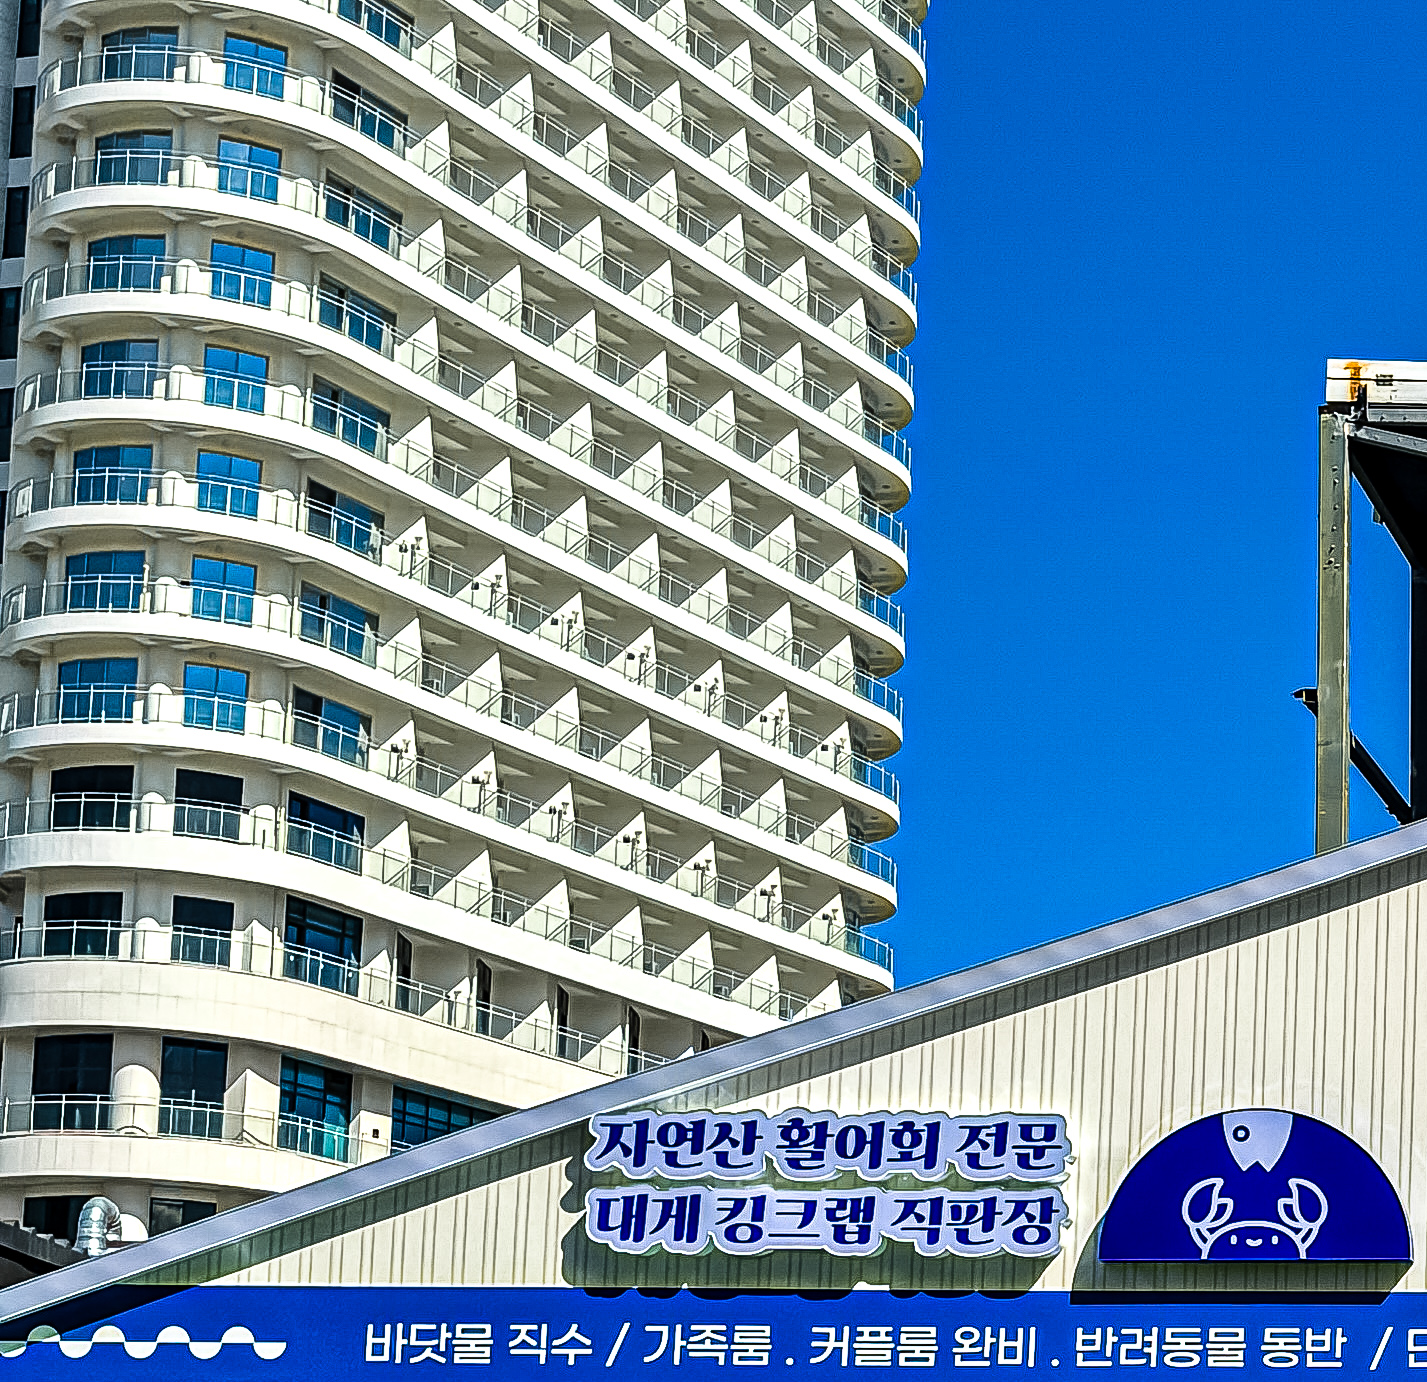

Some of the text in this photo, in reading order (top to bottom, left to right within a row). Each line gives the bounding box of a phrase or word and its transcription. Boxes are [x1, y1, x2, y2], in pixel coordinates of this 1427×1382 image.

[597, 1117, 1064, 1171] 자연산 활어회 전문
[595, 1194, 1060, 1246] 대게 킹크랩 직판장
[365, 1322, 494, 1364] 바닷물
[508, 1323, 593, 1366] 직수
[643, 1323, 773, 1366] 가족룸
[809, 1325, 939, 1367] 커플룸
[951, 1326, 1036, 1368] 완비
[1075, 1326, 1247, 1368] 반려동물
[1260, 1327, 1348, 1368] 동반
